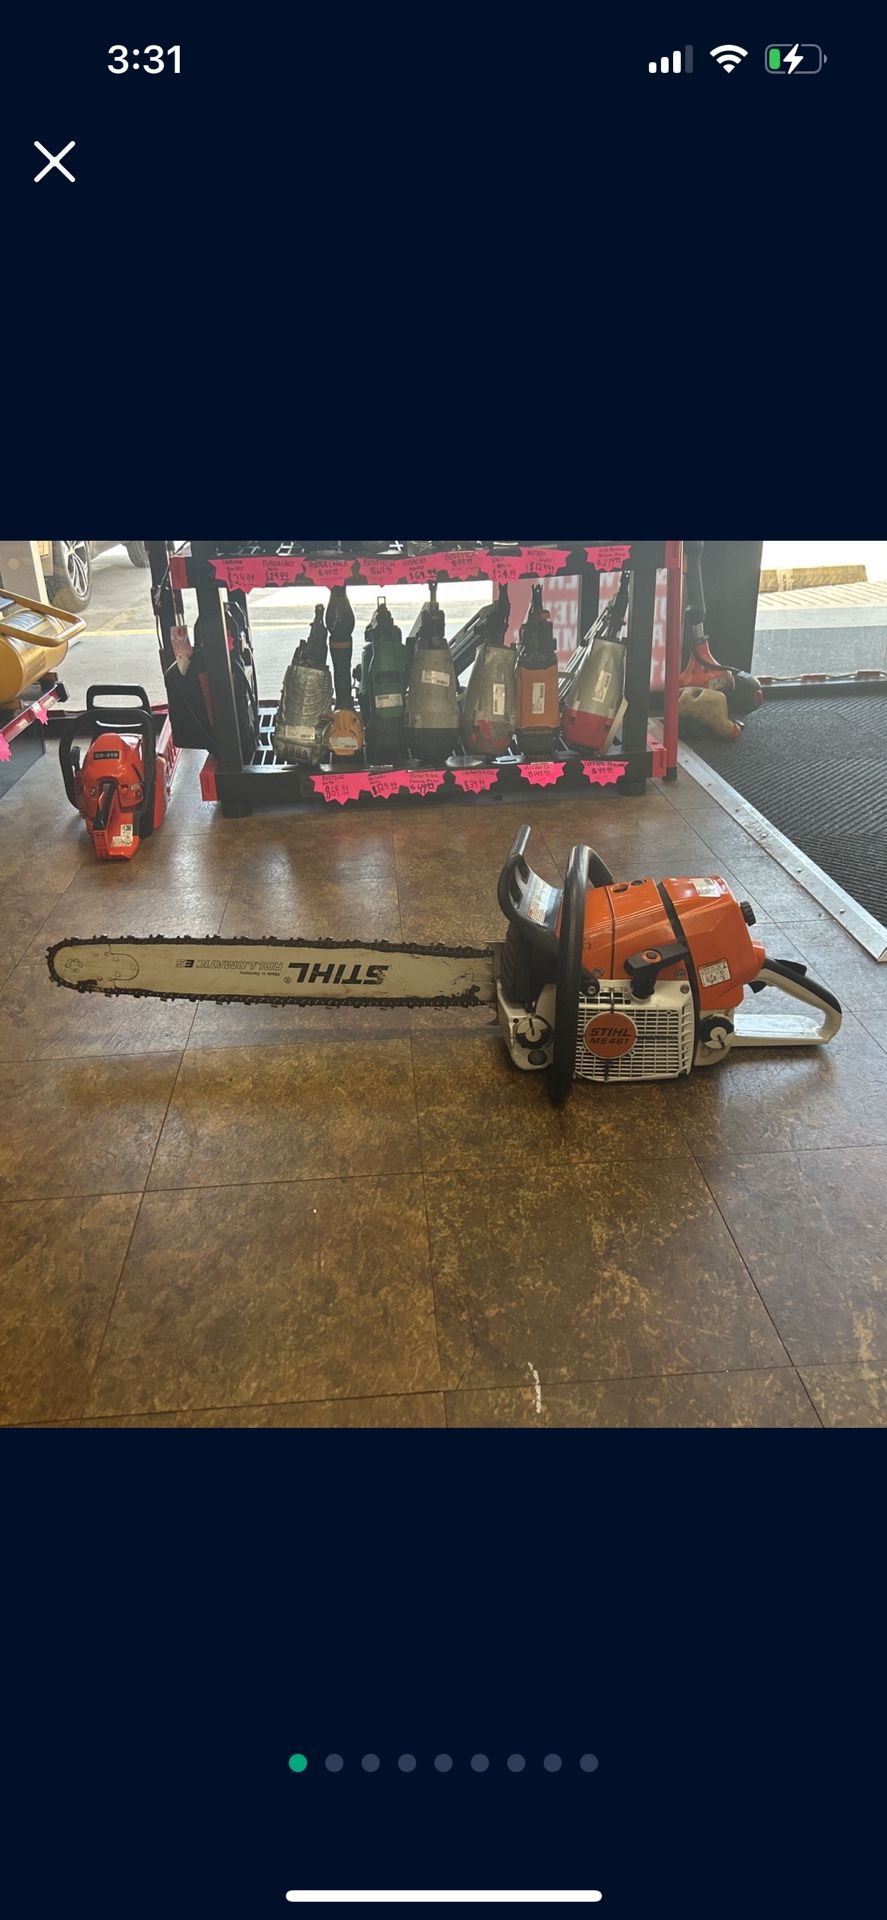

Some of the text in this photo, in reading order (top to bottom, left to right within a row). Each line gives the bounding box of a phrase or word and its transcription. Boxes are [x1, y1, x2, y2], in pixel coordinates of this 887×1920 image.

[175, 958, 284, 971] ROLLOMATIC ES
[288, 962, 389, 985] STIHL
[590, 1028, 631, 1037] STIHL
